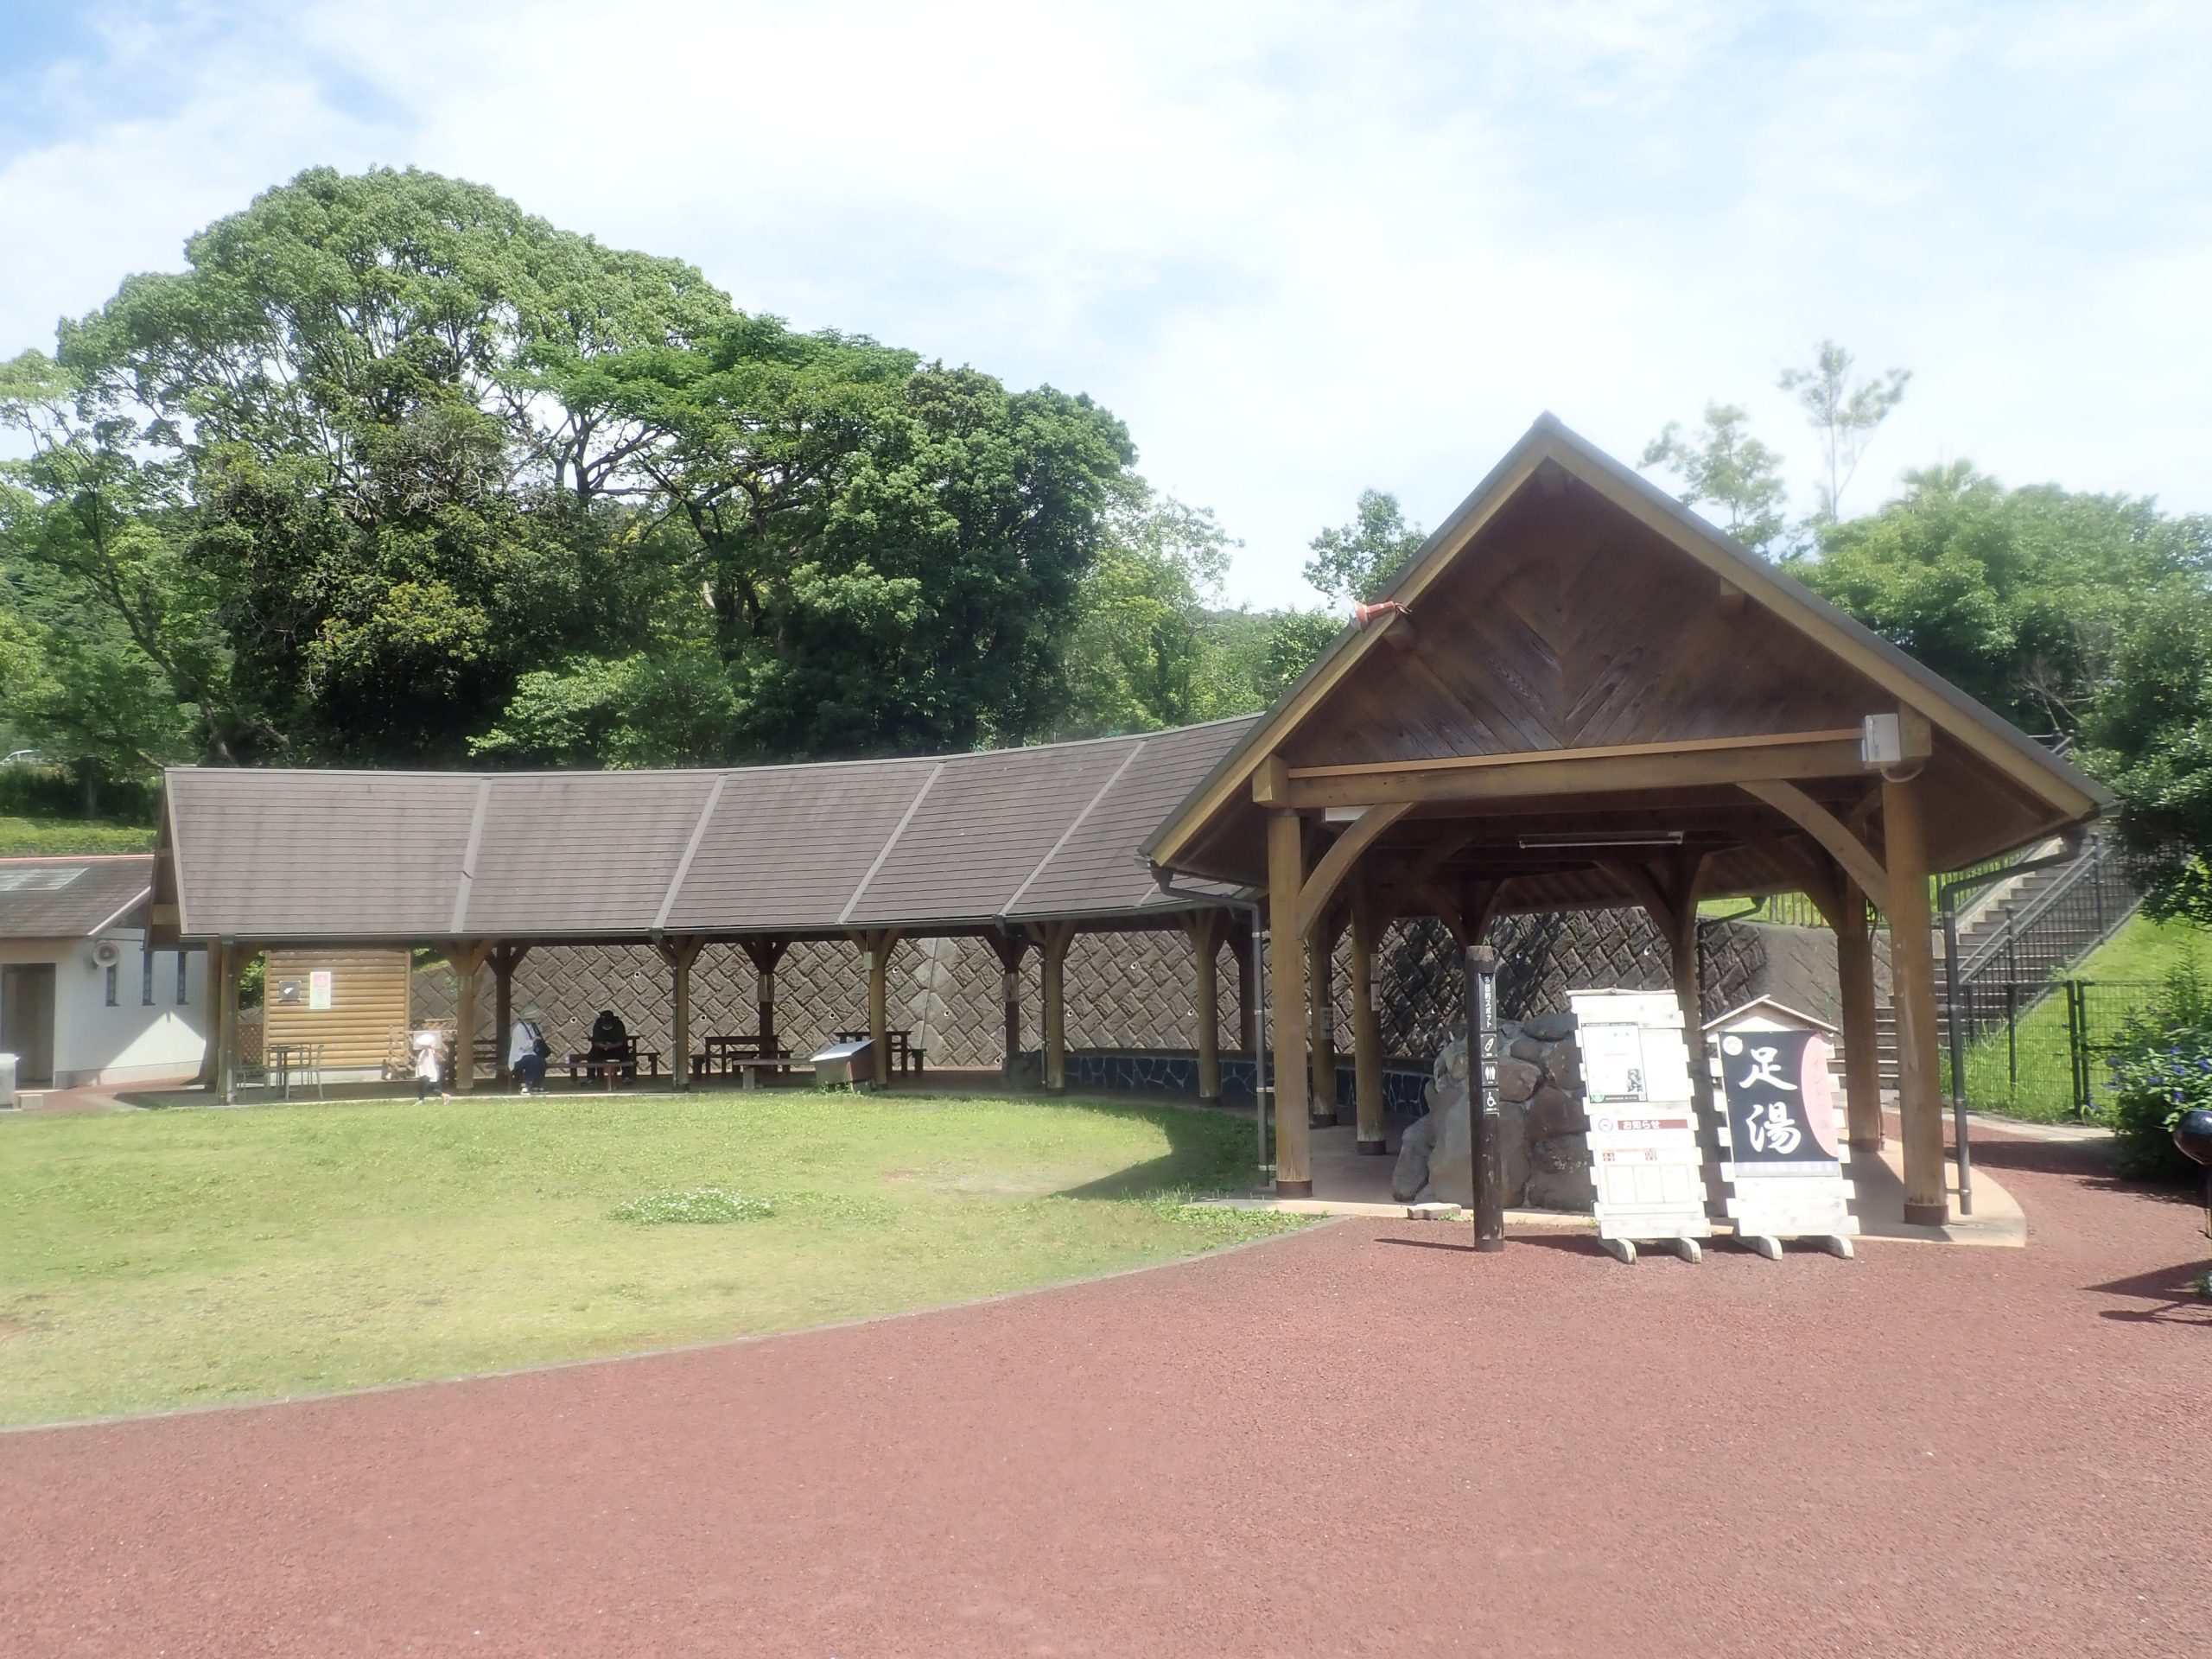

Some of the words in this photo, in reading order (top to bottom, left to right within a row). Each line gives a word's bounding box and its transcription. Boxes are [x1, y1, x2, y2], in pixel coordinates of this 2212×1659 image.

[1623, 1120, 1660, 1131] お知らせ
[1738, 1046, 1802, 1154] 足湯
